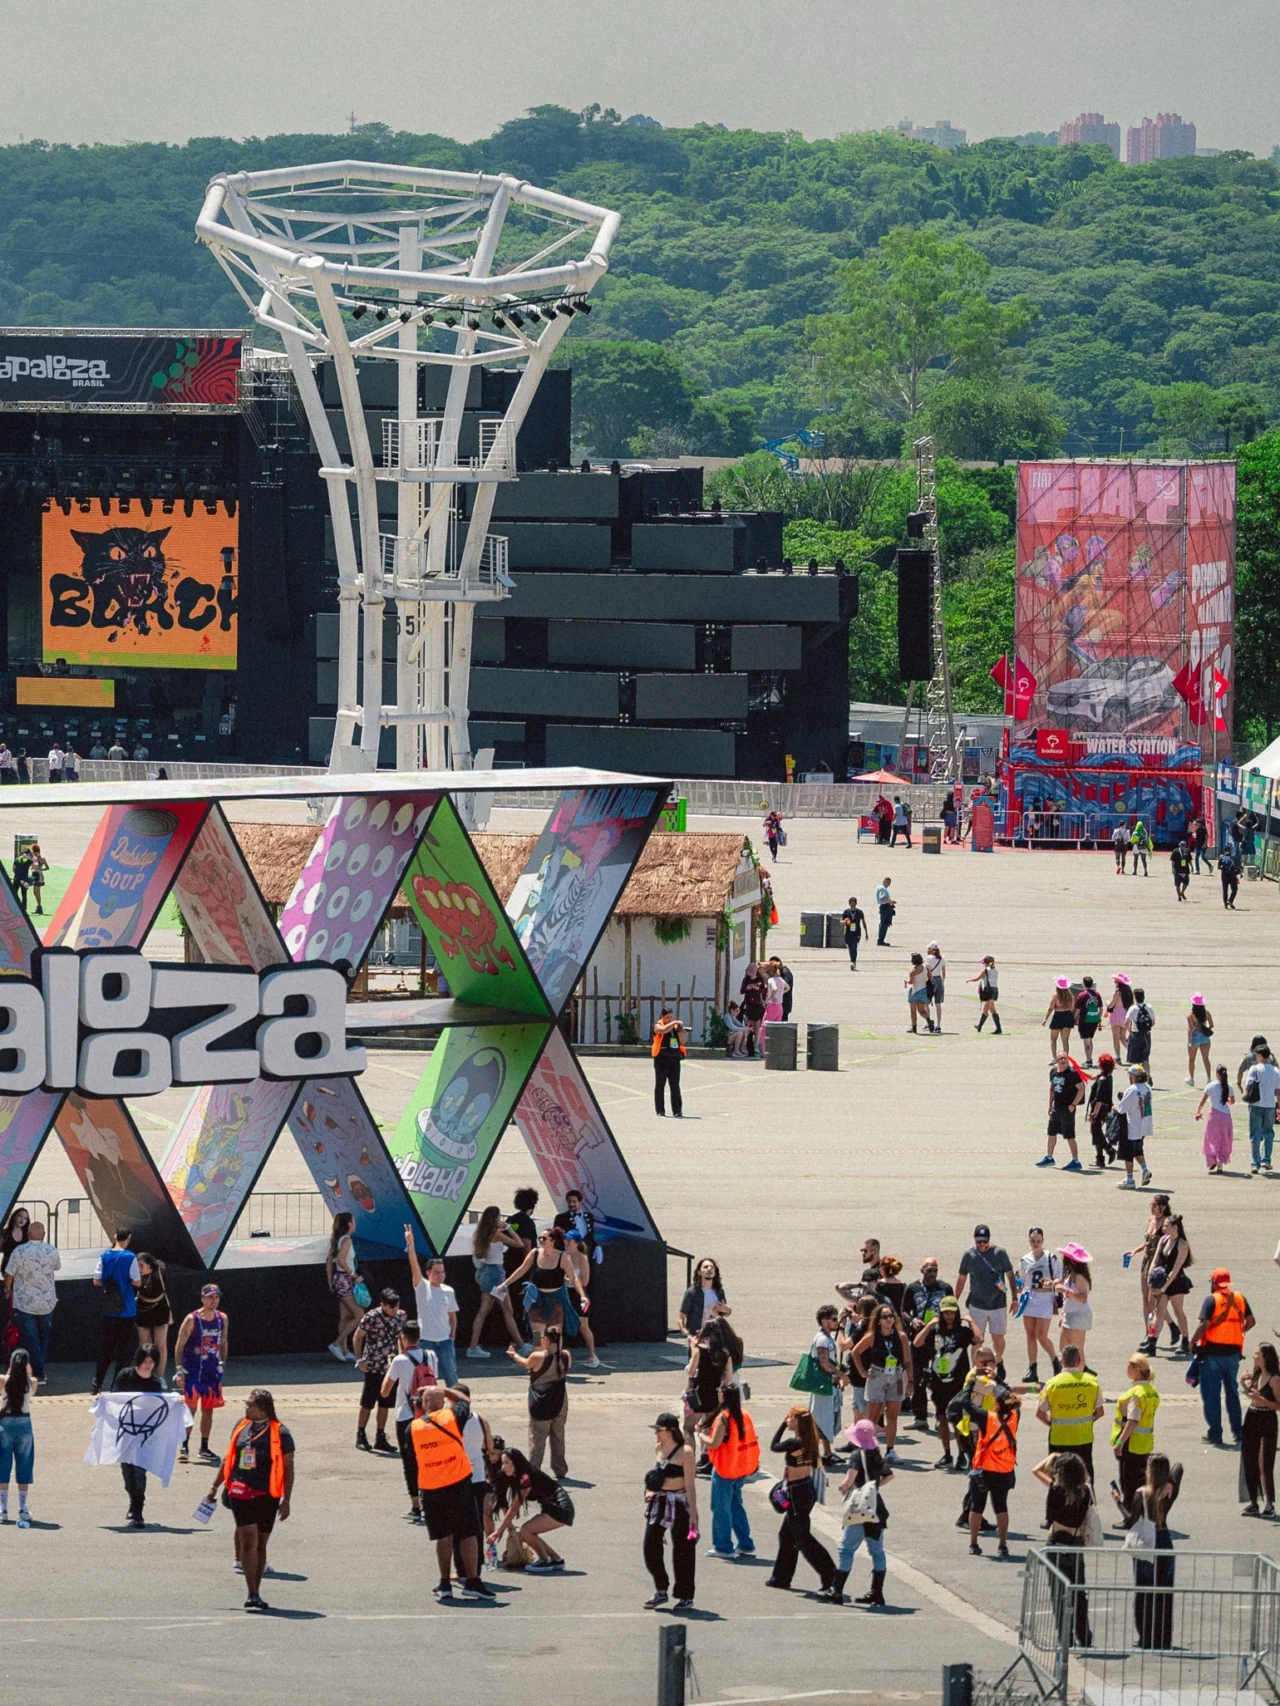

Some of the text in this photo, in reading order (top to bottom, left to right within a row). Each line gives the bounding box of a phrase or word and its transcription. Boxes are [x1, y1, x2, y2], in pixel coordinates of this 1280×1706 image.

[72, 379, 105, 388] BRASIL
[1086, 737, 1177, 755] WATER STATION
[101, 867, 145, 891] SOUP
